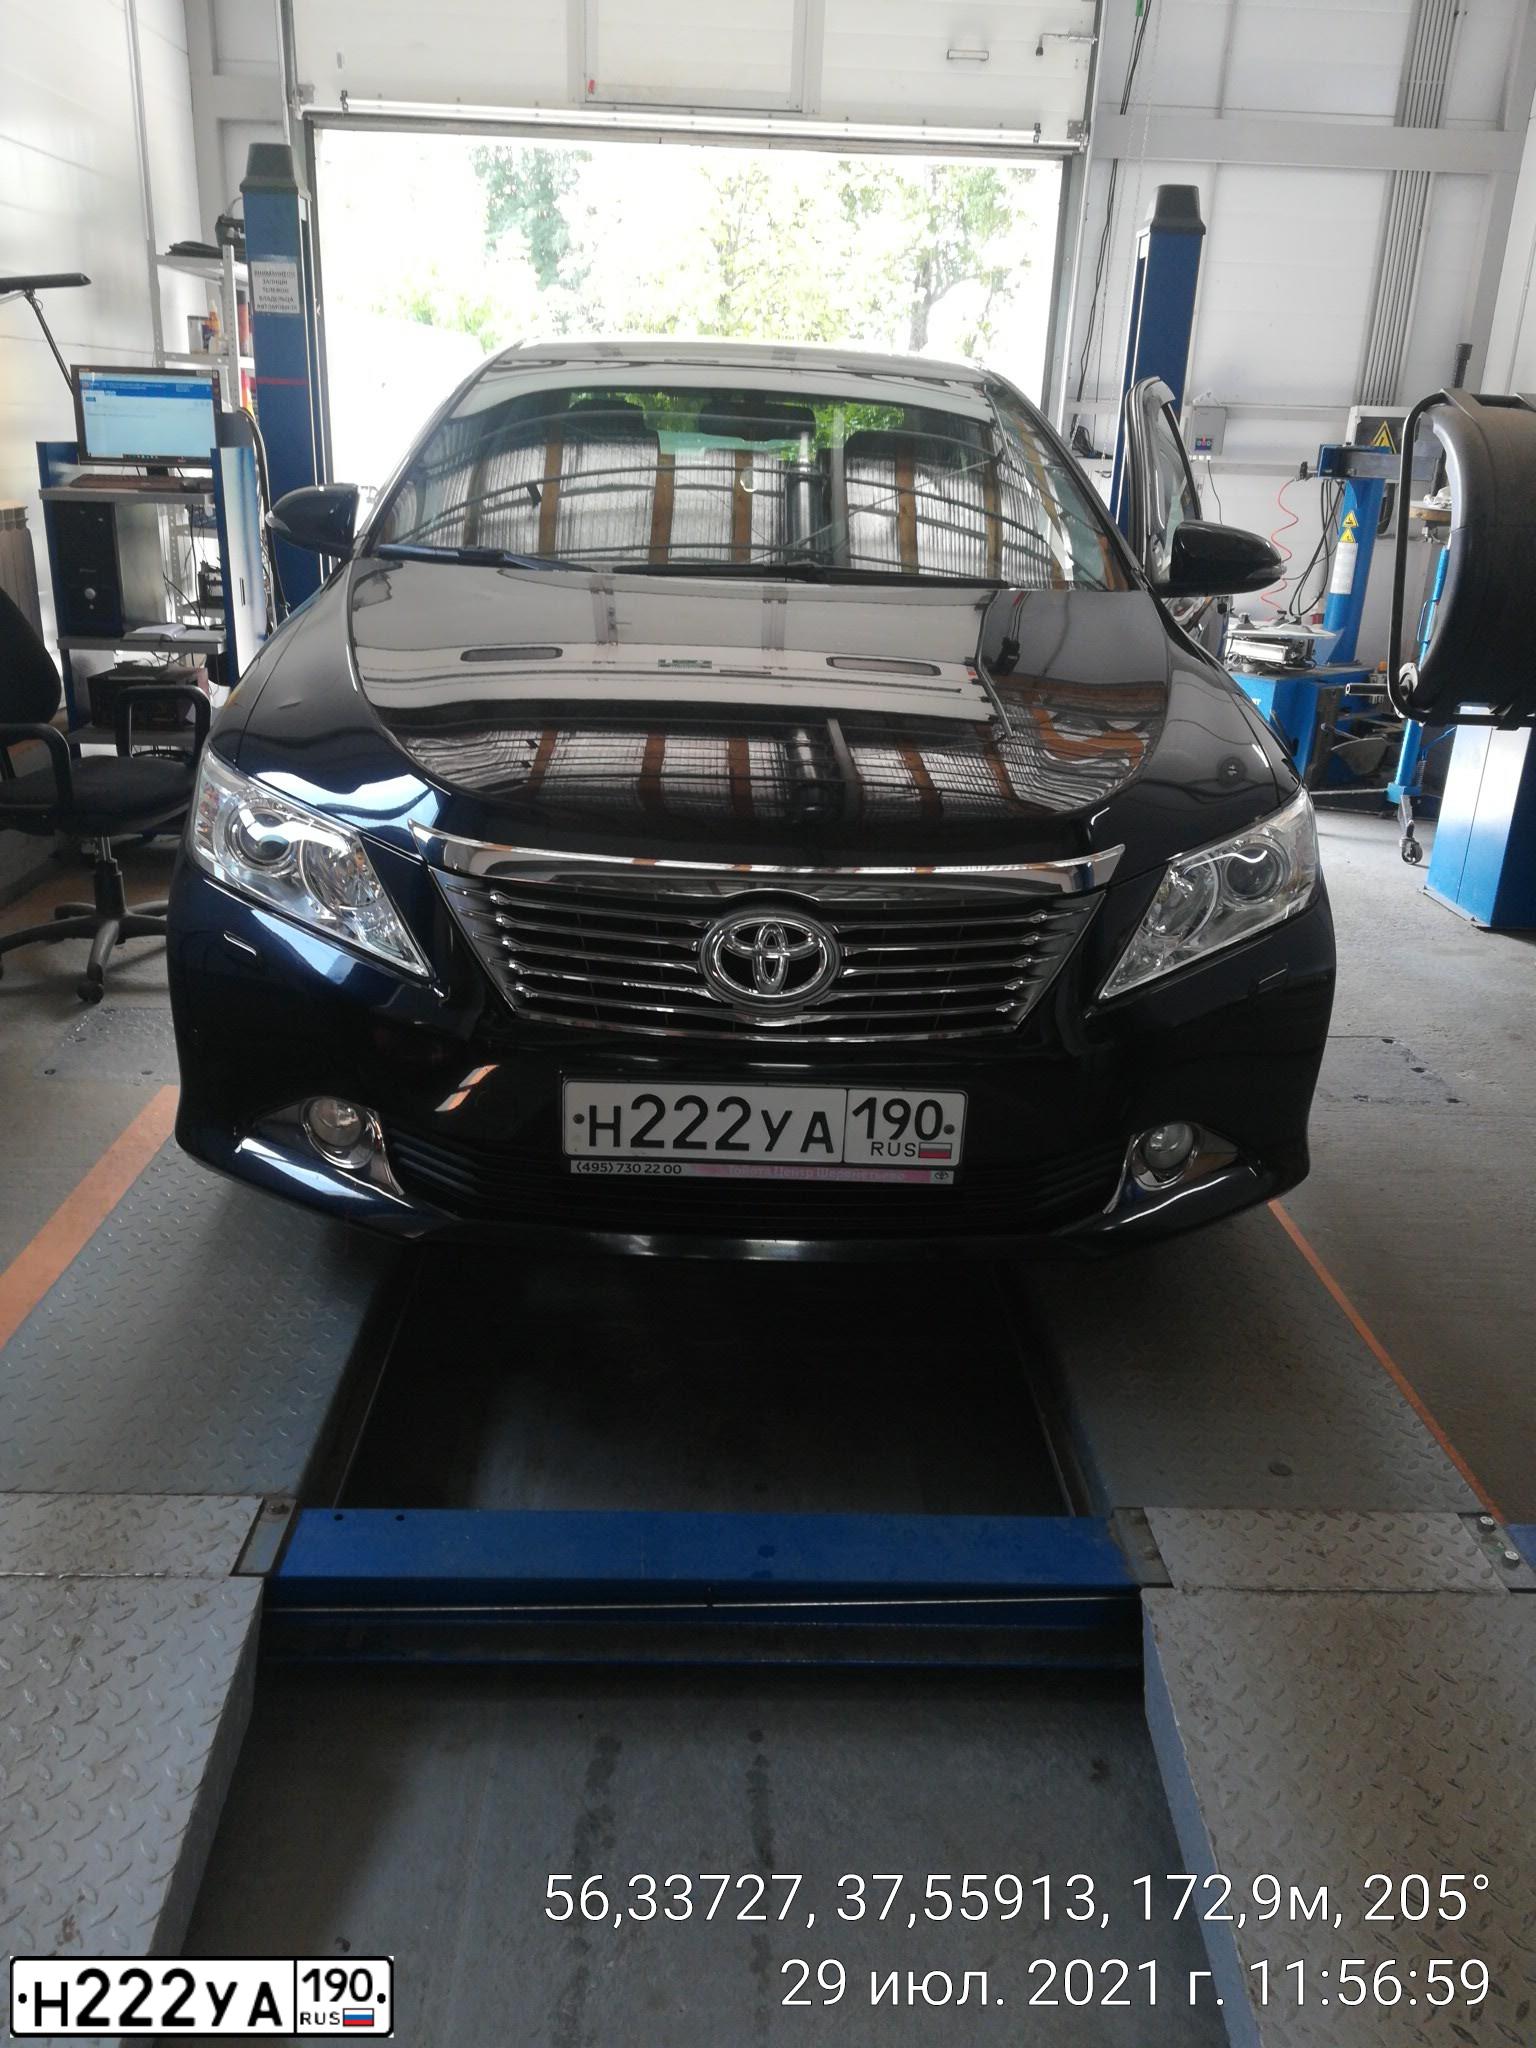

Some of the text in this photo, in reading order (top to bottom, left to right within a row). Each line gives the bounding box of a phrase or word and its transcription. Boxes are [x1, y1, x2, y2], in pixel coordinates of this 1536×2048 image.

[852, 1097, 943, 1142] 190
[871, 1141, 917, 1158] RUS
[576, 1161, 682, 1175] (495) 730 22 00
